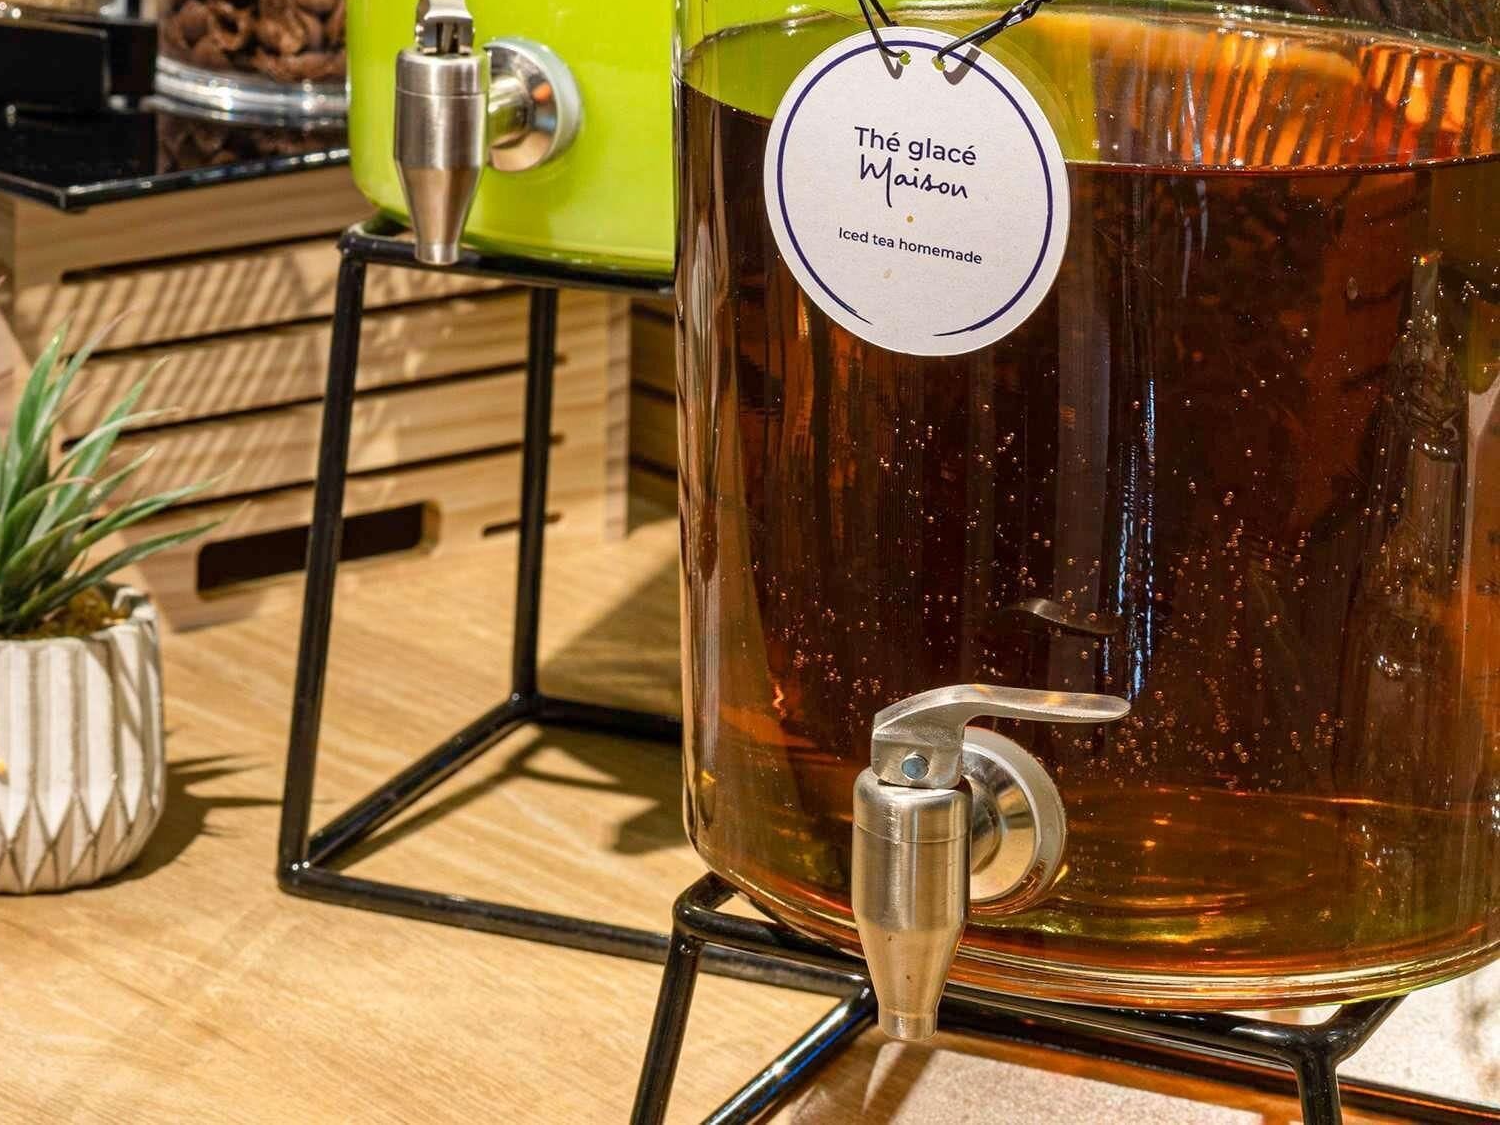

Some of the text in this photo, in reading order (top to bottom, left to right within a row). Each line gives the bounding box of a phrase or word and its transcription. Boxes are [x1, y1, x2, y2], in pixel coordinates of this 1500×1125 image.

[854, 126, 977, 166] Thé glacé
[860, 154, 969, 208] Maison
[838, 227, 983, 265] Iced tea homemade
